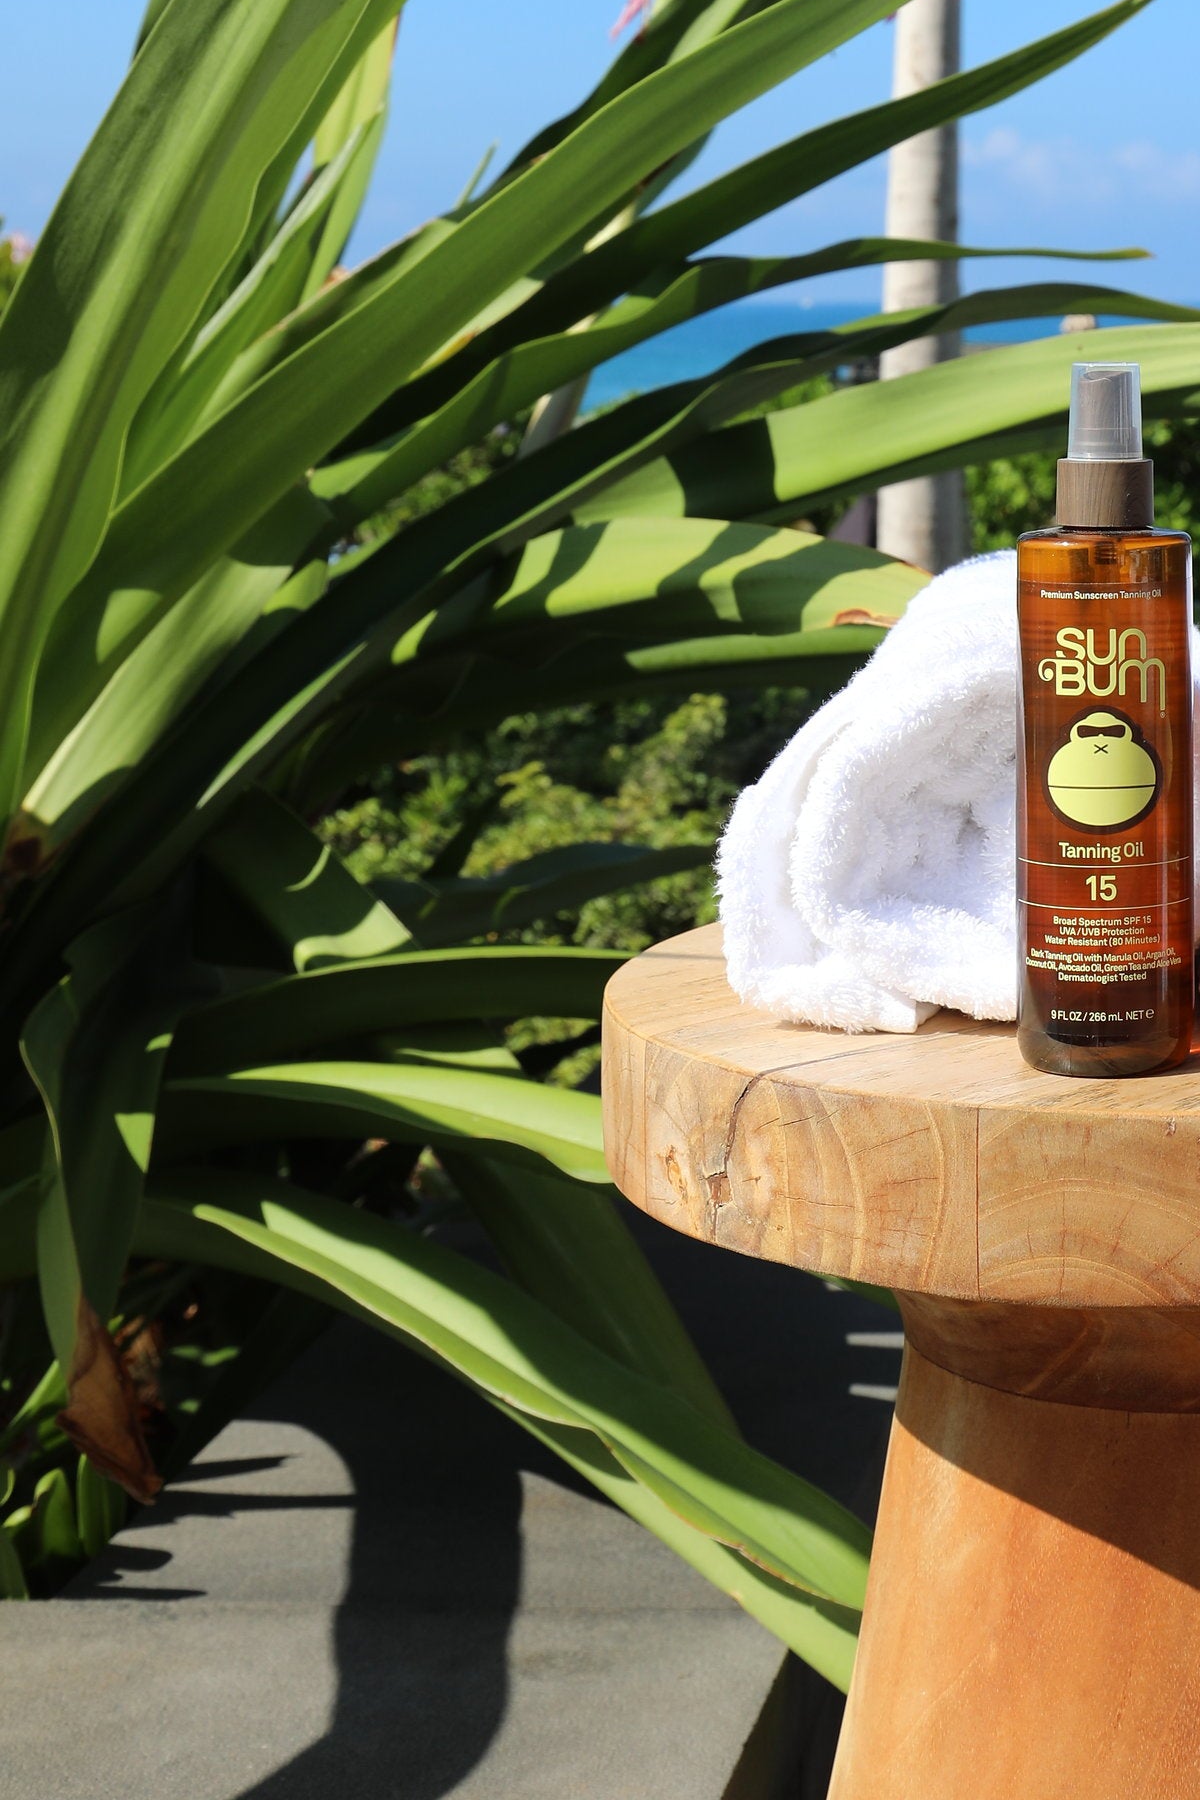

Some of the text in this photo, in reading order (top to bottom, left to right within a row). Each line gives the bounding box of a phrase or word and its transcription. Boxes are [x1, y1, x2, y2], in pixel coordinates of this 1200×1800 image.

[1040, 589, 1162, 600] Premium Sunscreen Tanning Oil
[1058, 842, 1144, 862] Tanning Oil
[1085, 875, 1117, 901] 15
[1053, 916, 1151, 927] Broad Spectrum SPF 15
[1102, 927, 1144, 936] Protection
[1045, 934, 1160, 947] Water Resistant (80 Minutes)
[1030, 948, 1044, 958] Dark
[1044, 950, 1072, 963] Tanning
[1073, 952, 1084, 961] Oil
[1084, 952, 1102, 962] with
[1103, 952, 1132, 962] Marula
[1133, 952, 1145, 961] Oil,
[1146, 950, 1165, 960] Argan
[1025, 957, 1182, 973] Coconut Oil, Avocado Oil, Green Tea and Aloe Vera
[1058, 972, 1147, 984] Dermatologist Tested
[1051, 1009, 1057, 1019] 9
[1057, 1011, 1069, 1021] FL
[1070, 1012, 1082, 1021] OZ
[1089, 1011, 1106, 1022] 266
[1108, 1011, 1123, 1021] mL
[1126, 1009, 1144, 1020] NET
